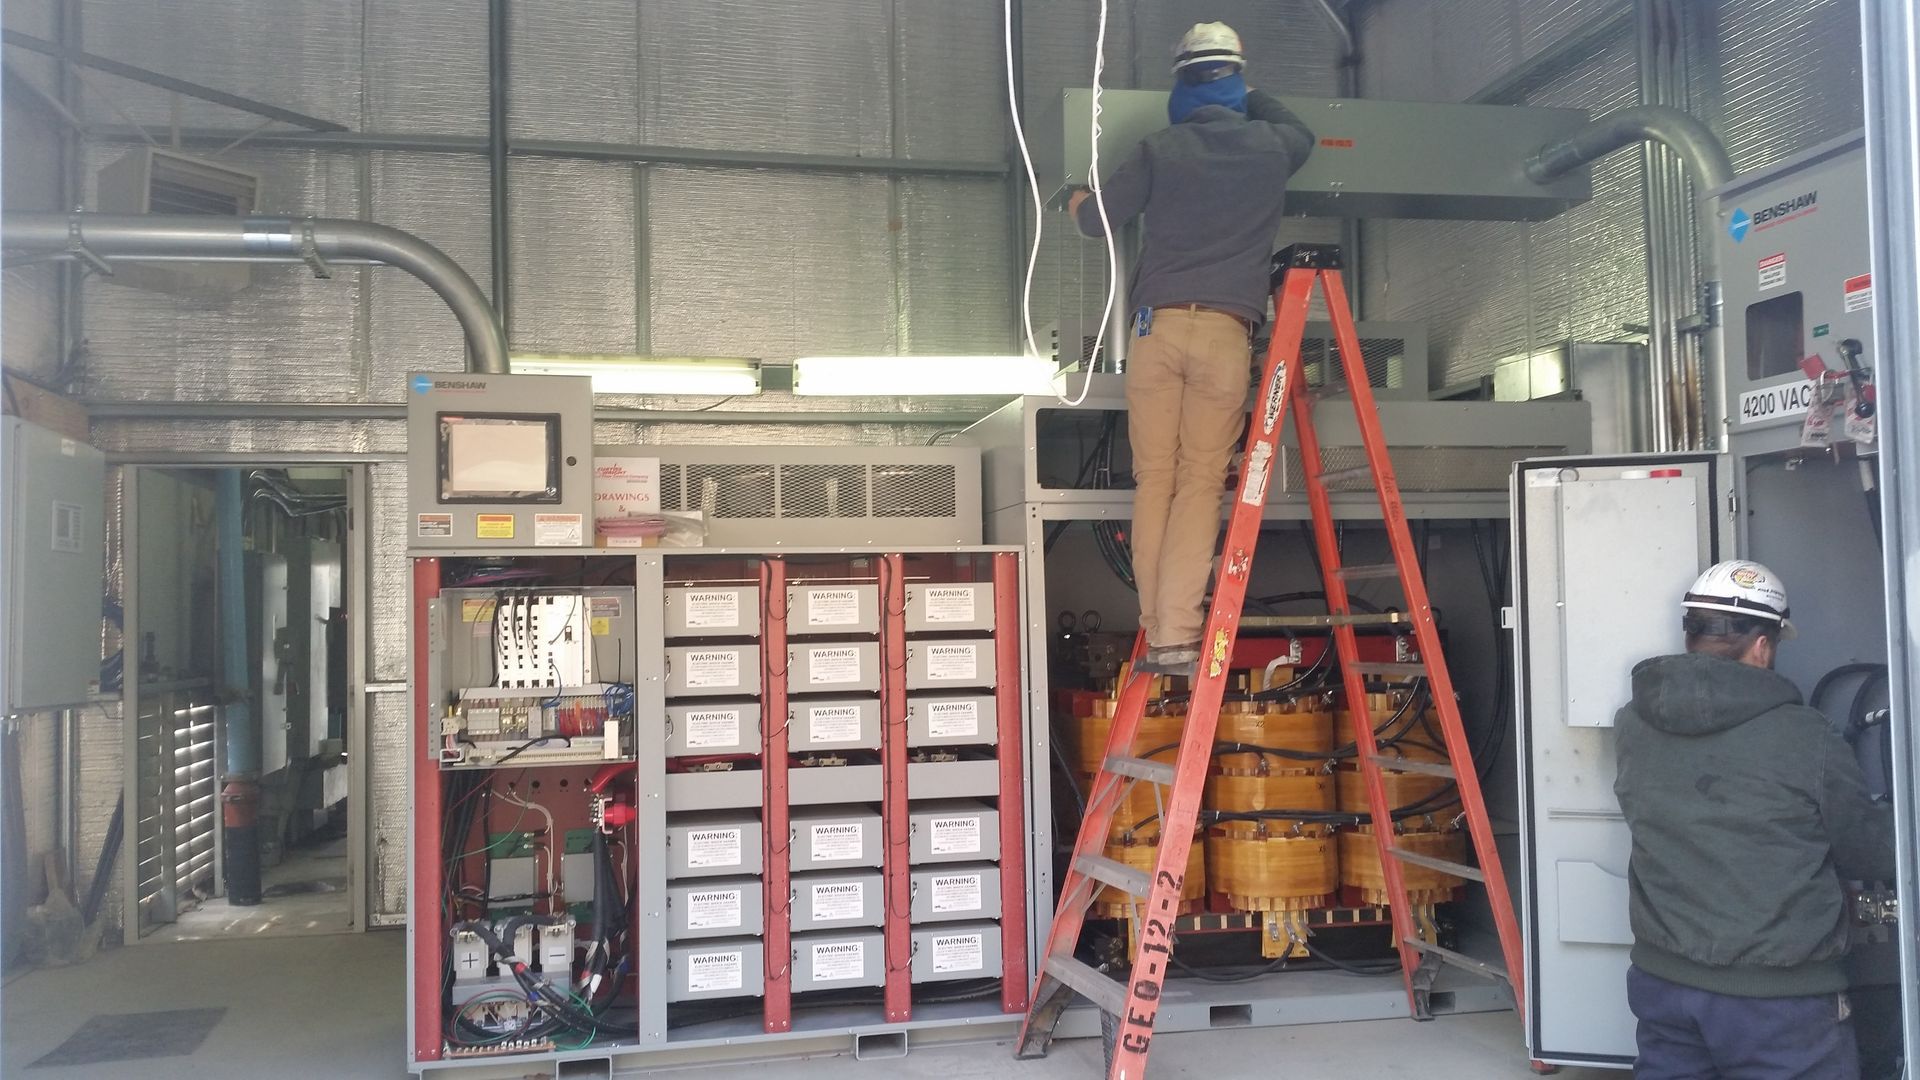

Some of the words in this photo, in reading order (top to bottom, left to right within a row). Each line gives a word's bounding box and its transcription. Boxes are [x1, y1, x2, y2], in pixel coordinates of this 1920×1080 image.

[1753, 191, 1817, 225] BENSHAW
[434, 381, 487, 389] BENSHAW
[1743, 392, 1775, 418] 4200
[1779, 384, 1811, 411] VAC
[594, 492, 650, 502] DRAWINGS
[618, 504, 626, 512] &
[934, 817, 977, 829] WARNING:
[815, 824, 860, 834] WARNING:
[692, 830, 738, 841] WARNING:
[935, 876, 978, 887] WARNING:
[816, 884, 860, 895] WARNING:
[692, 892, 738, 902] WARNING:
[936, 936, 979, 947] WARNING:
[816, 943, 861, 954] WARNING:
[692, 953, 739, 964] WARNING:
[1122, 870, 1184, 1055] GEO-12-2
